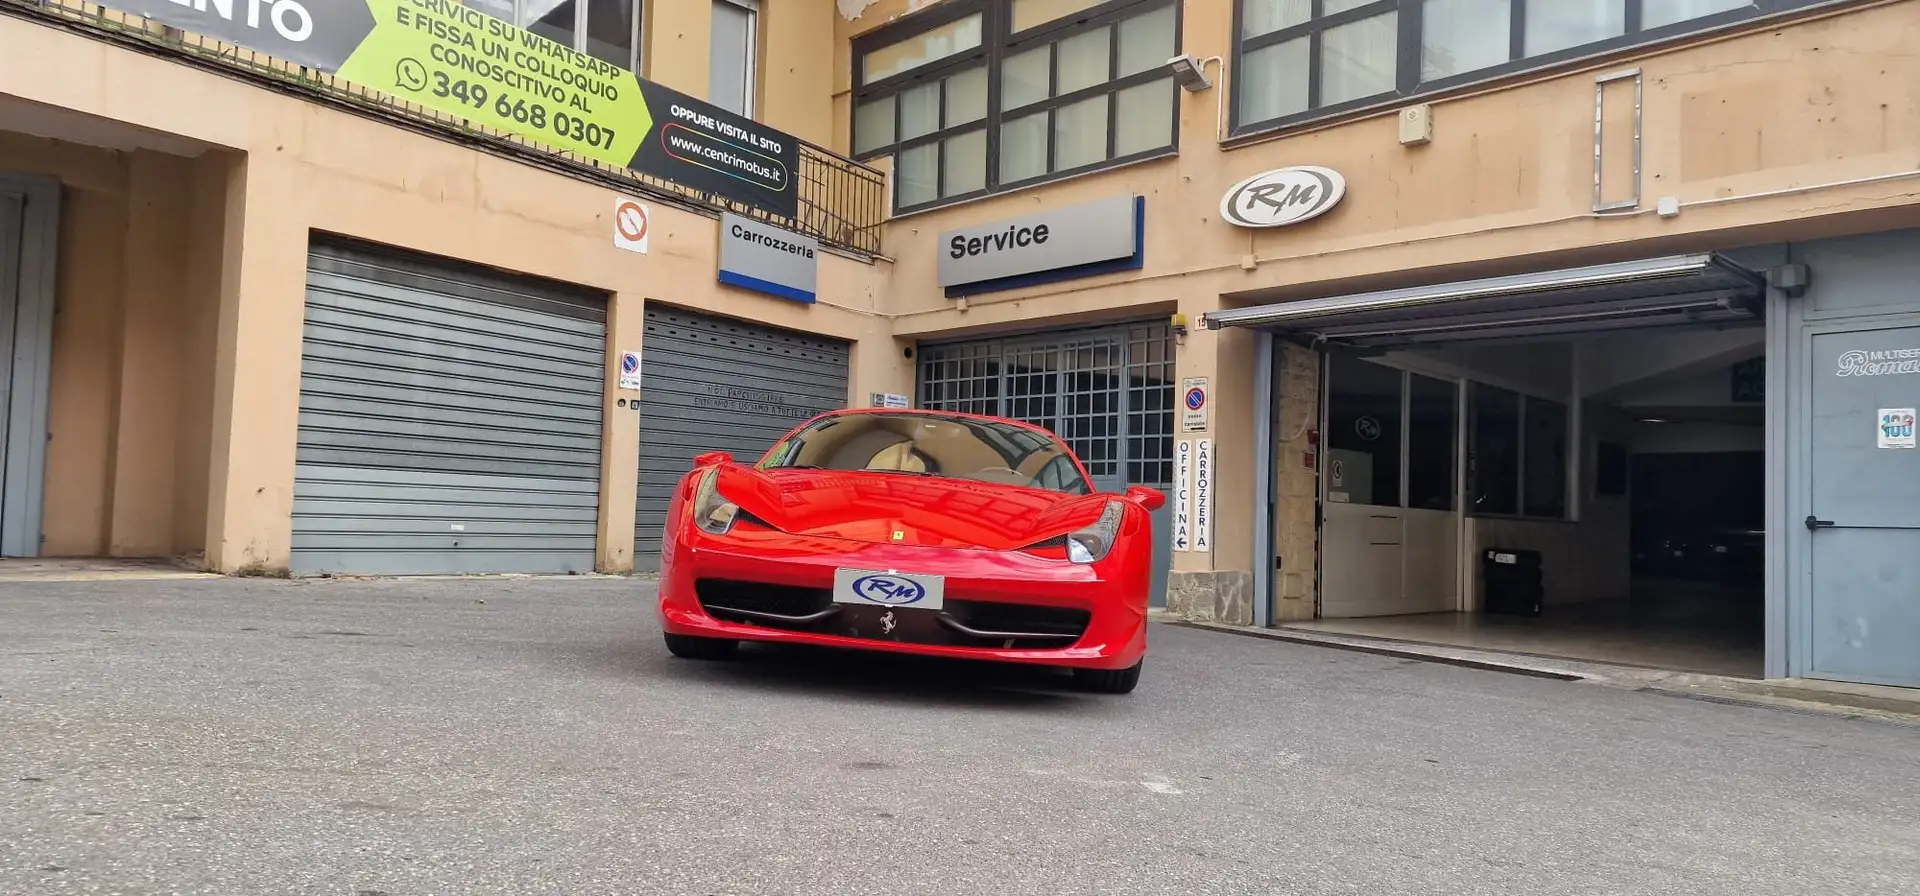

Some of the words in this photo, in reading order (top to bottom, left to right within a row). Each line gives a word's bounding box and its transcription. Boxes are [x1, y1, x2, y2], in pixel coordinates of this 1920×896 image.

[397, 6, 409, 26] E
[416, 13, 476, 51] FISSA
[482, 38, 509, 63] UN
[514, 51, 618, 101] COLLOQUIO
[489, 16, 515, 41] SU
[520, 30, 620, 80] WHATSAPP
[430, 43, 565, 103] CONOSCITIVO
[569, 93, 592, 114] AL
[432, 70, 488, 109] 349
[495, 93, 547, 129] 668
[554, 112, 615, 150] 0307
[670, 104, 715, 129] OPPURE
[716, 120, 749, 143] VISITA
[750, 133, 759, 146] IL
[760, 137, 782, 154] SITO
[670, 136, 781, 182] www.centrimotus.it
[1246, 183, 1317, 217] RM
[731, 224, 814, 259] Carrozzeria
[950, 224, 1049, 259] Service
[1178, 442, 1189, 536] OFFICINA
[1197, 441, 1208, 547] CARROZZERIA
[868, 579, 915, 600] RM
